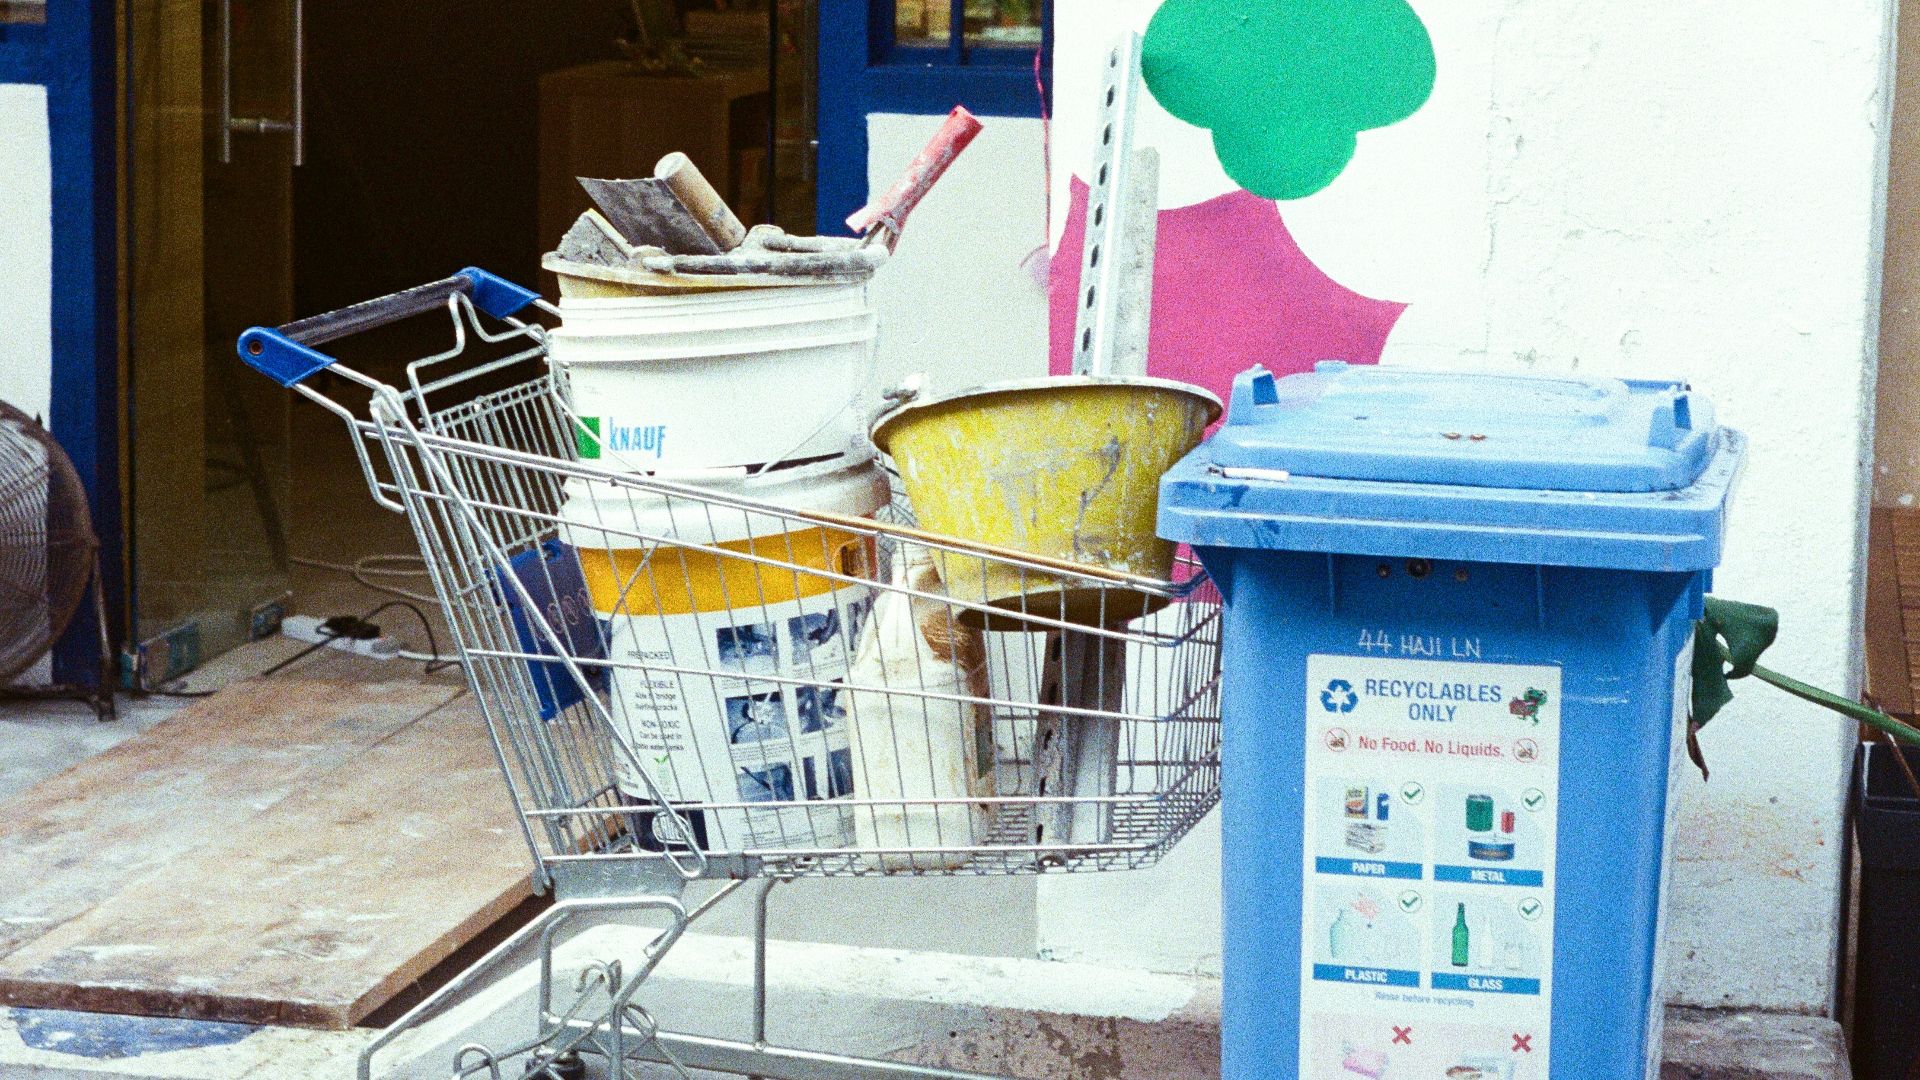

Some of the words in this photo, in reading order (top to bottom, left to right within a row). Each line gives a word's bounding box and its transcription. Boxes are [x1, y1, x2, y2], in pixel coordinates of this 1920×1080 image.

[609, 417, 666, 458] KNAUF
[1358, 629, 1392, 653] 44
[1400, 635, 1441, 656] HAJI
[1452, 637, 1482, 658] LN
[1365, 678, 1502, 703] RECYCLABLES
[1408, 703, 1457, 722] ONLY
[1359, 736, 1377, 750] No
[1382, 737, 1420, 754] Food.
[1424, 740, 1443, 754] No
[1448, 742, 1505, 758] Liquids.
[1352, 863, 1385, 876] PAPER
[1471, 870, 1506, 883] METAL
[1344, 969, 1388, 984] PLASTIC
[1467, 978, 1503, 991] GLASS
[1402, 993, 1430, 1003] before
[1433, 996, 1475, 1008] recycling
